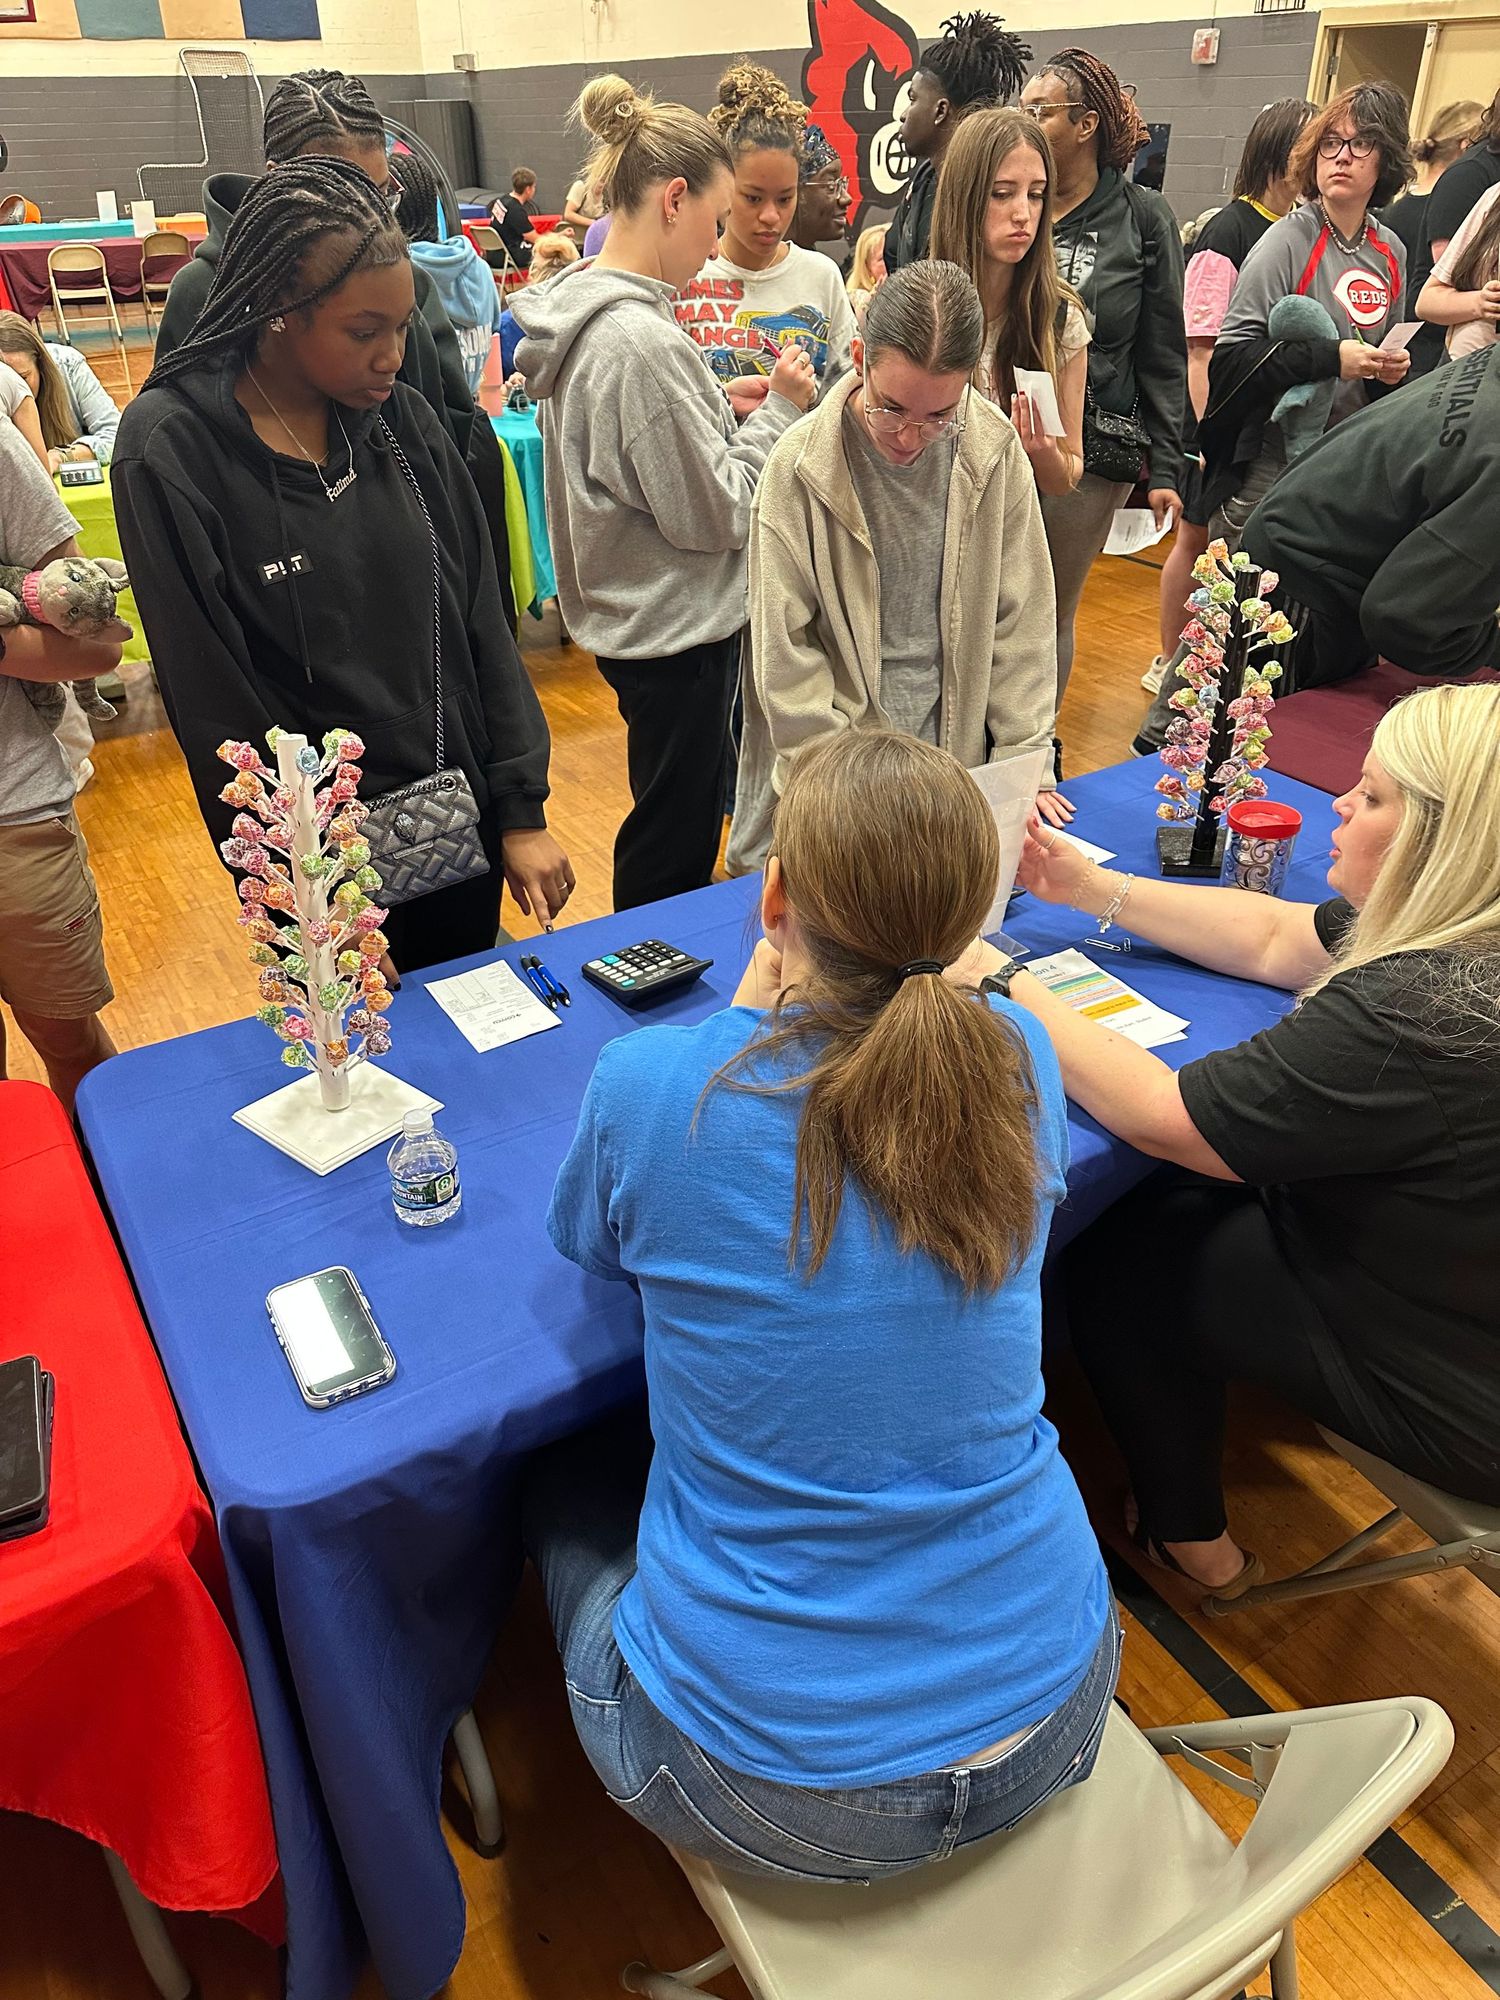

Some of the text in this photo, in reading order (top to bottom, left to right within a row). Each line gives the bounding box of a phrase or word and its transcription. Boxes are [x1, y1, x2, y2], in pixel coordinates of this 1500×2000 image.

[1348, 289, 1388, 307] REDS
[674, 302, 739, 324] MAY
[456, 322, 492, 359] SON
[686, 327, 764, 350] ANGE
